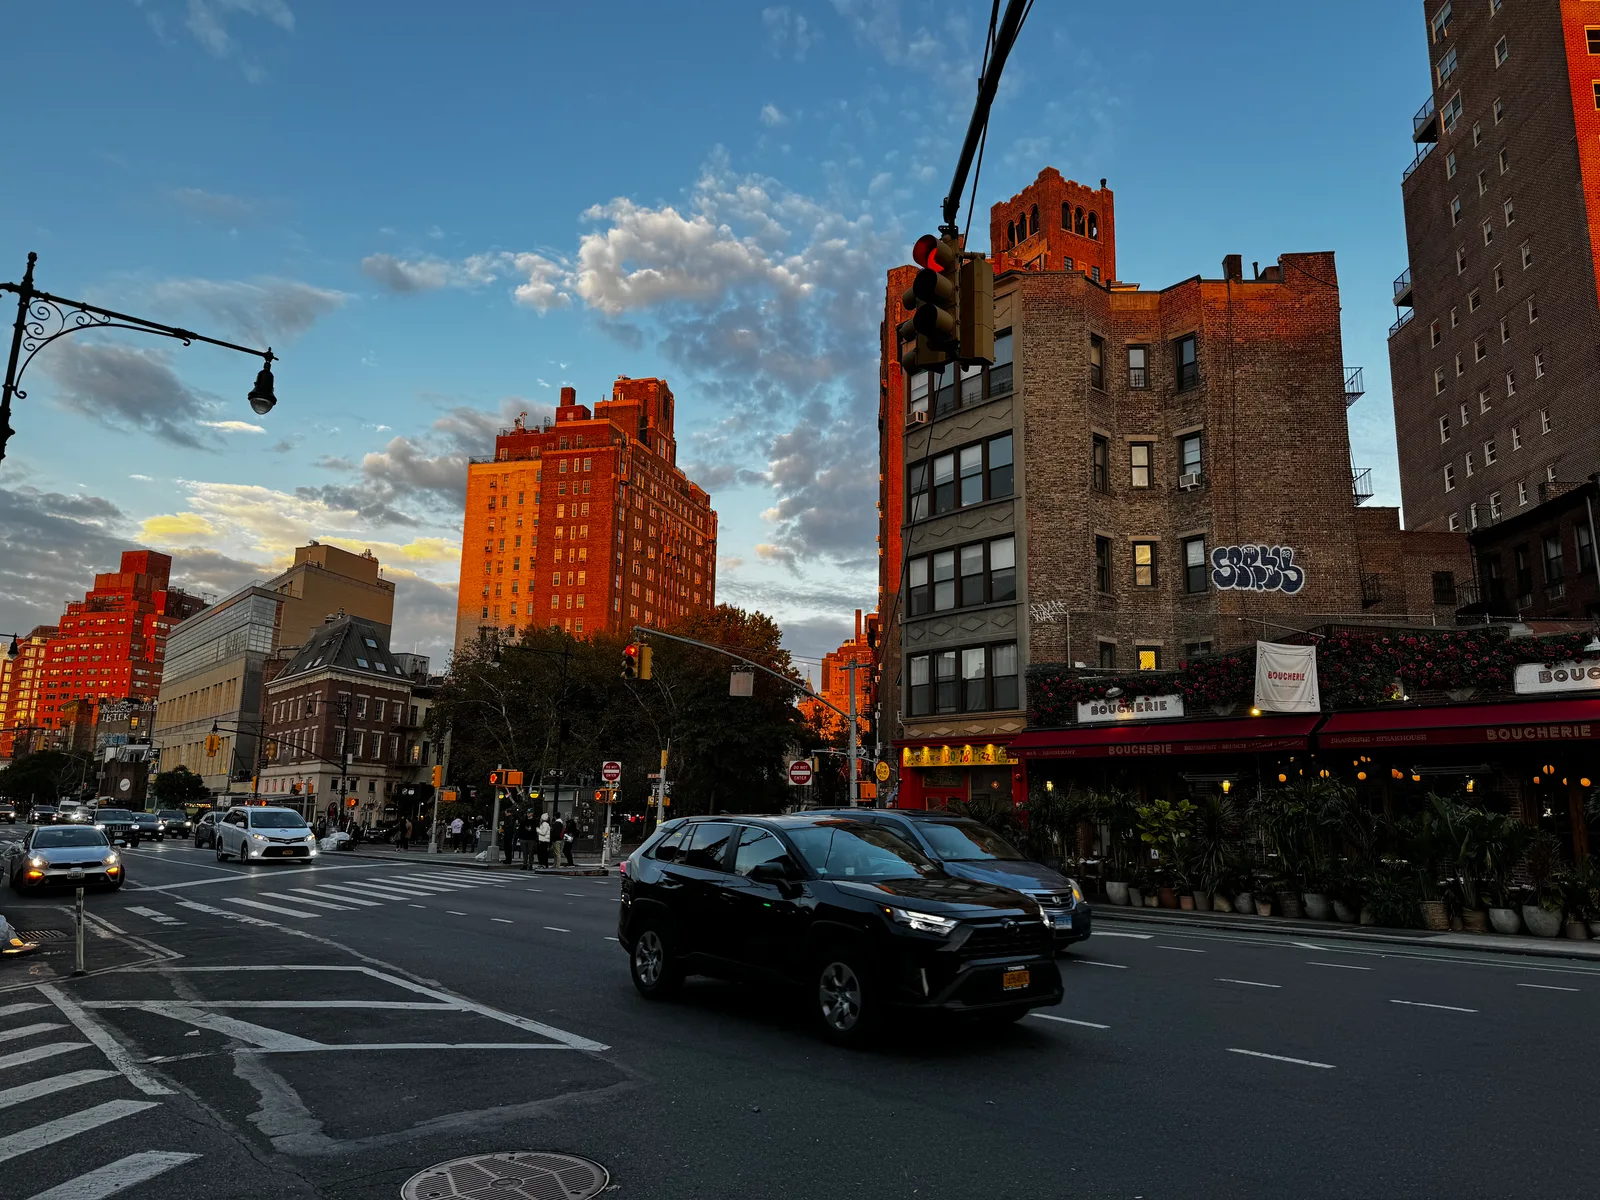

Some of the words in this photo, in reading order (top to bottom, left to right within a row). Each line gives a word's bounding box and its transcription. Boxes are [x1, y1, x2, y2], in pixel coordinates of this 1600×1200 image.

[1267, 671, 1306, 682] BOUCHERIE
[1538, 667, 1600, 684] BOUC
[1090, 701, 1168, 716] BOUCHERIE
[1330, 735, 1371, 745] BRASSERIE
[1376, 733, 1427, 744] STEAKHOUSE
[1485, 724, 1593, 742] BOUCHERIE
[1108, 744, 1173, 756] BOUCHERIE
